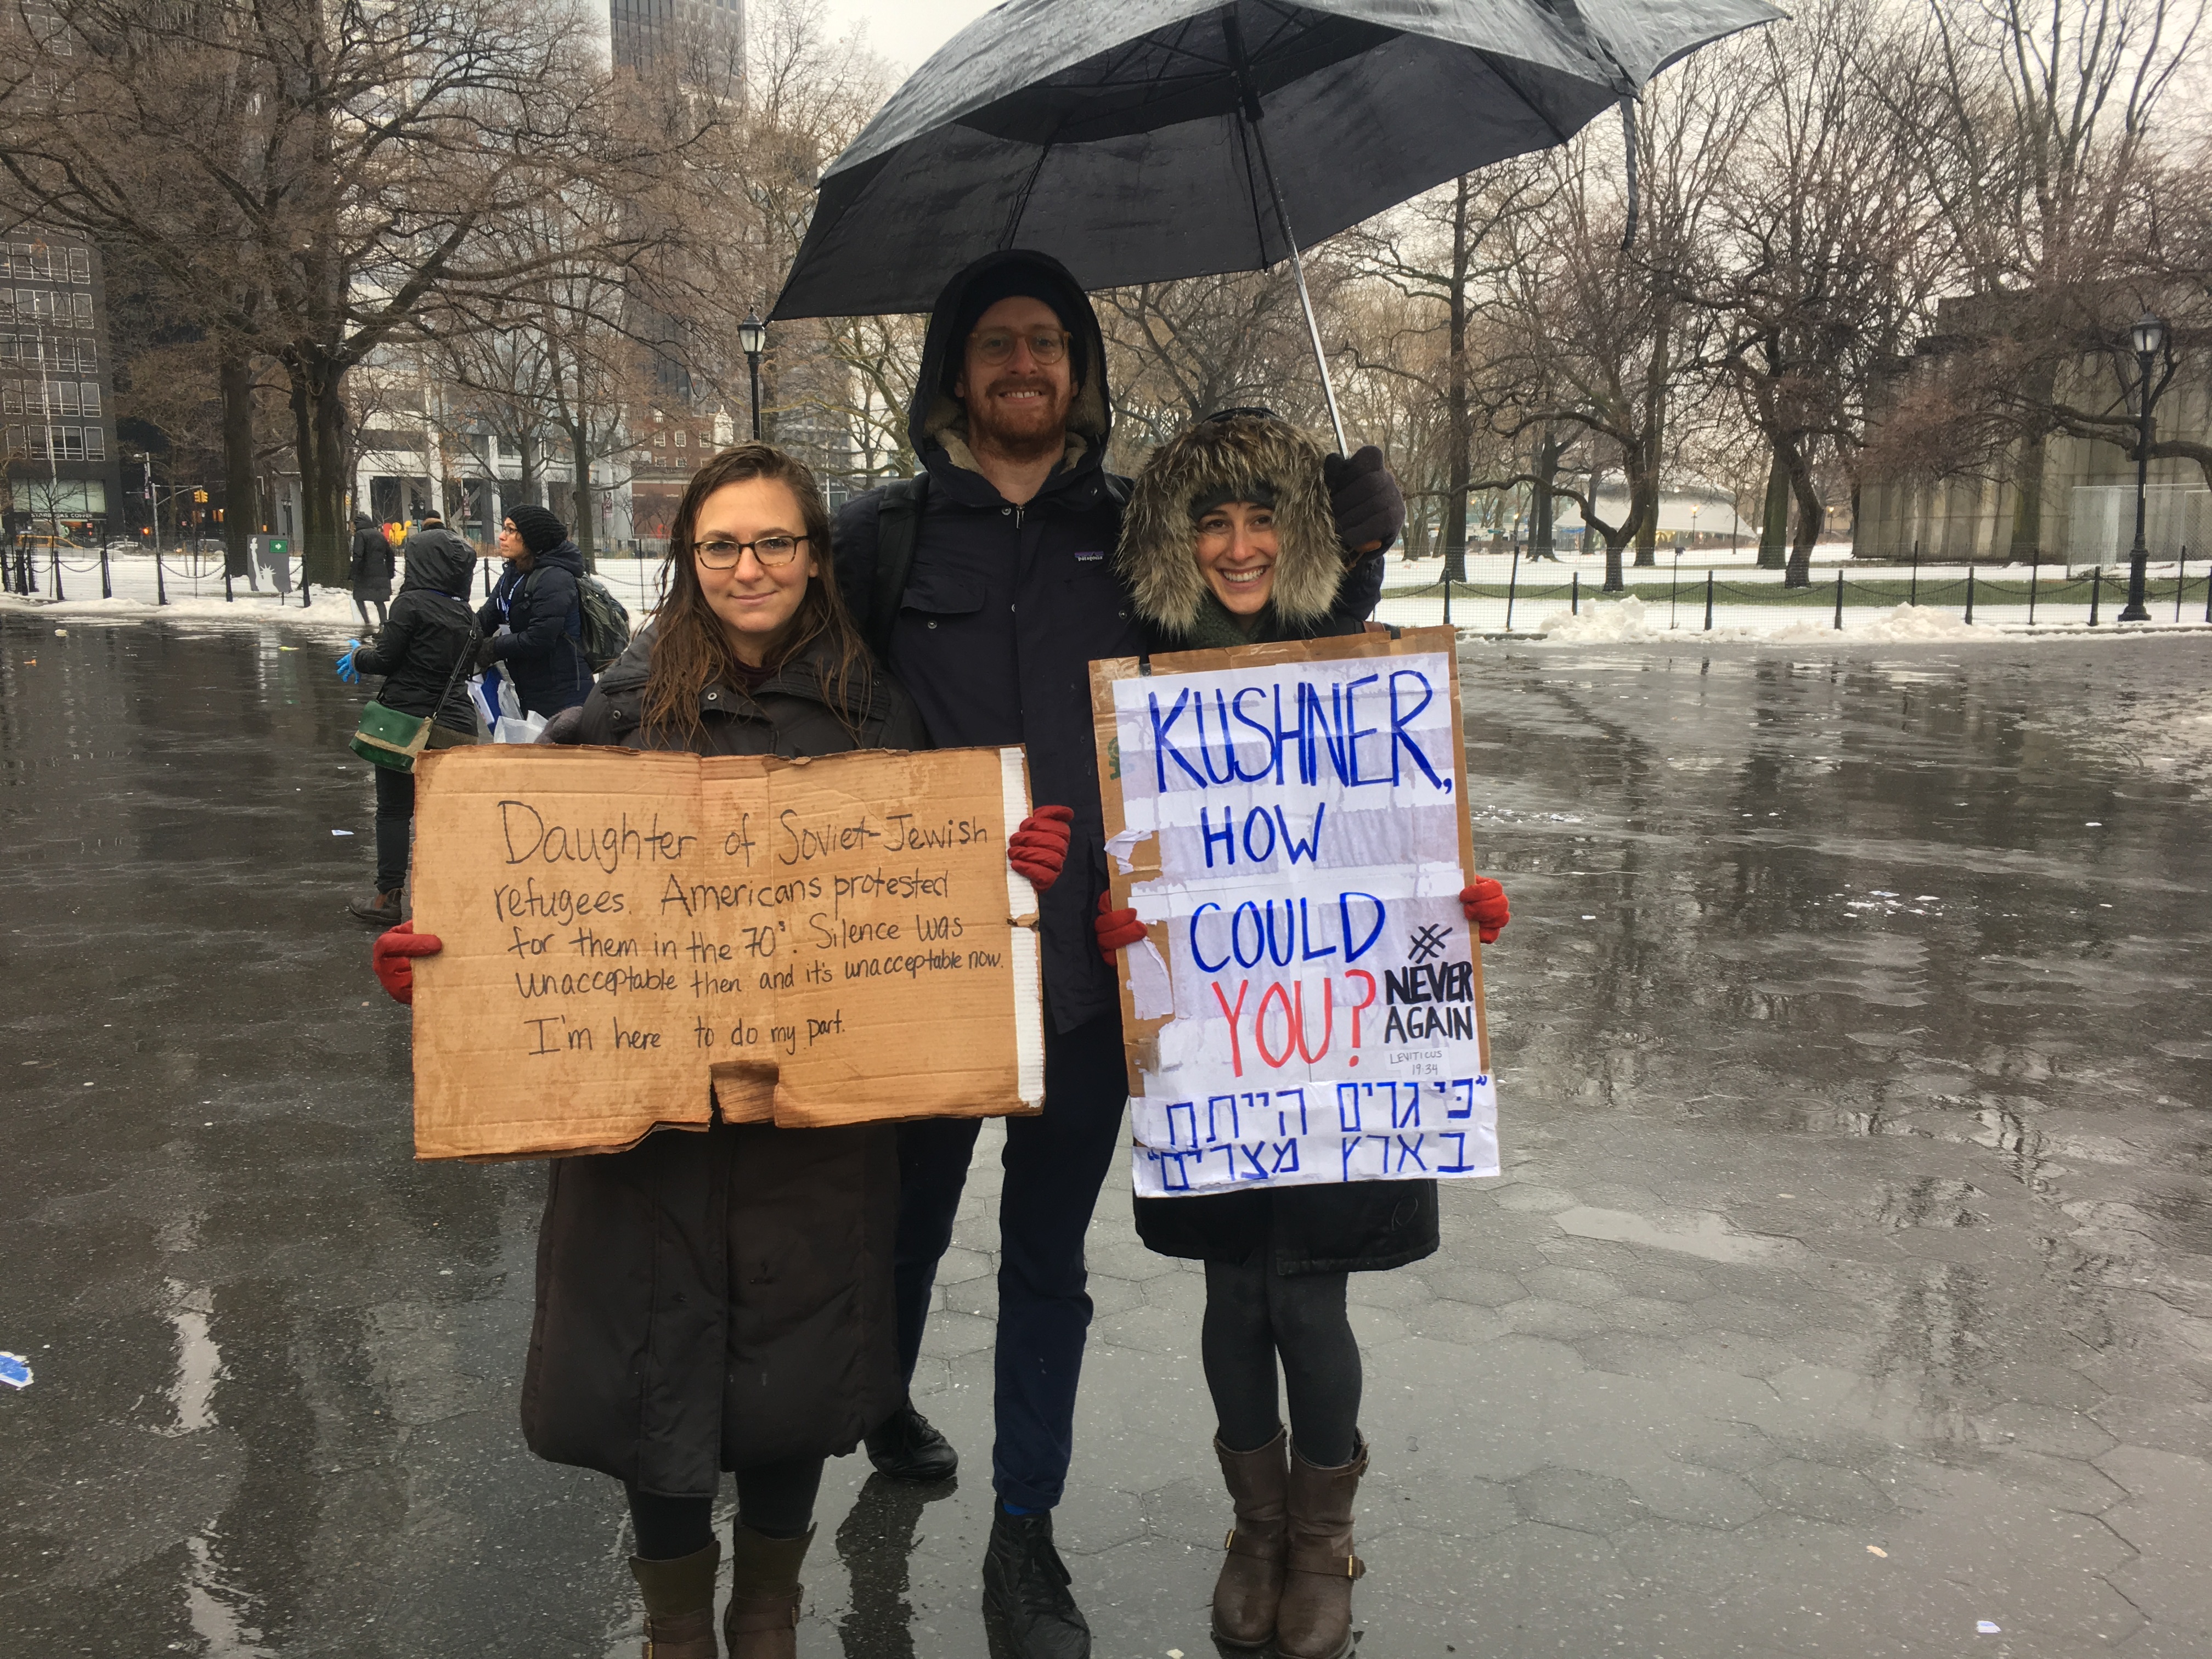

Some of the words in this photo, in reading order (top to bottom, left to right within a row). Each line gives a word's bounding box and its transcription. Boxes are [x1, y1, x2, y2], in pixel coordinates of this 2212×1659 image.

[1148, 669, 1452, 794] KUSHNER,
[496, 799, 697, 874] Daughter
[725, 812, 755, 867] of
[778, 809, 988, 865] Soviet-Jewish
[1200, 802, 1325, 868] HOW
[493, 877, 633, 926] refugees.
[661, 873, 822, 917] Americans
[834, 867, 949, 921] protested
[507, 926, 555, 960] for
[568, 927, 638, 957] them
[654, 933, 678, 960] in
[686, 931, 732, 964] the
[809, 912, 901, 949] Silence
[916, 915, 963, 941] was
[1189, 891, 1386, 973] COULD
[516, 965, 678, 998] unacceptable
[690, 969, 742, 998] then
[759, 963, 794, 990] and
[806, 960, 833, 985] it's
[845, 949, 962, 979] unacceptable
[968, 951, 1005, 970] now.
[1384, 961, 1474, 1005] NEVER
[523, 1014, 593, 1056] I'm
[613, 1016, 662, 1050] here
[694, 1015, 715, 1048] to
[730, 1018, 759, 1047] do
[770, 1029, 795, 1056] my
[807, 1009, 845, 1046] part.
[1211, 969, 1376, 1077] YOU?
[1384, 1006, 1474, 1043] AGAIN
[1390, 1050, 1443, 1064] LEVITICUS
[1336, 1081, 1421, 1132] גרים
[1343, 1132, 1475, 1182] בארץ
